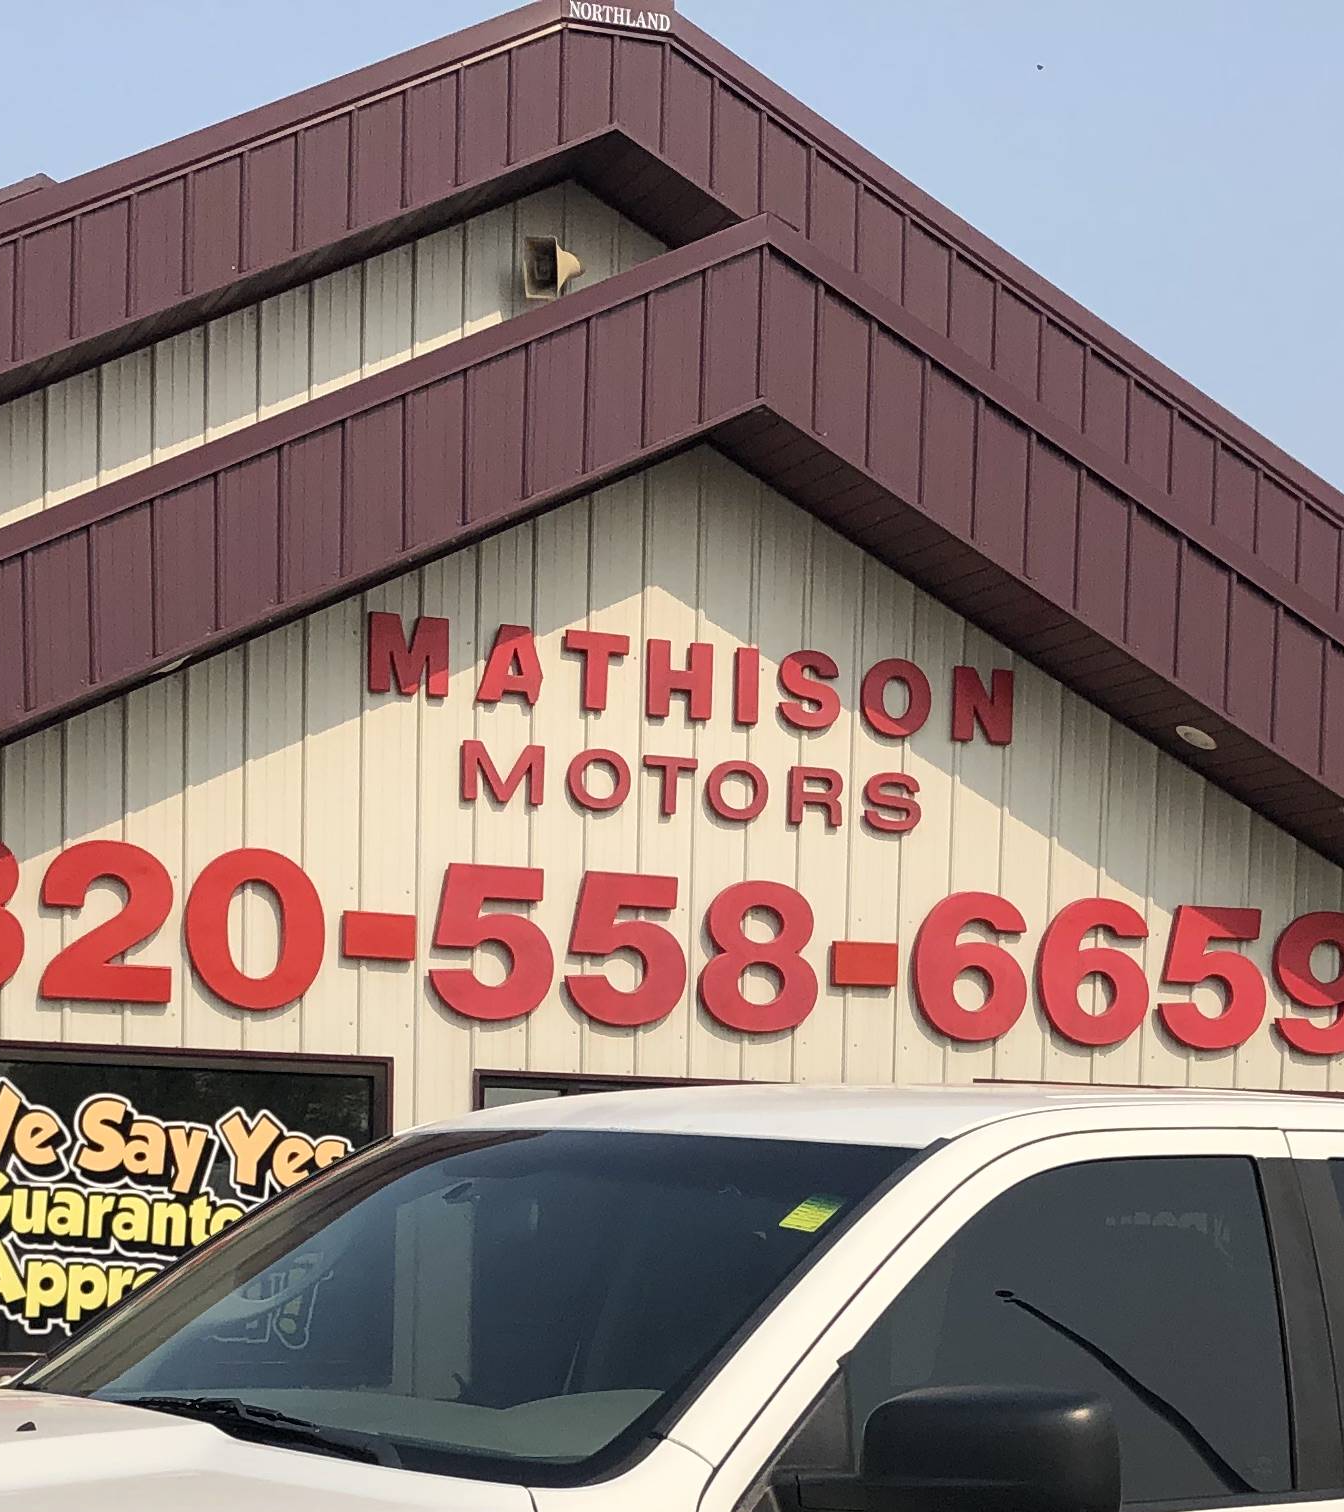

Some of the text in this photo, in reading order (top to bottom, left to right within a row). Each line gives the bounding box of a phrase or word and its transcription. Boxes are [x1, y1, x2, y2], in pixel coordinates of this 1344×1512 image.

[568, 0, 671, 32] NORTHLAND
[367, 610, 1014, 746] MATHISON
[459, 739, 923, 833] MOTORS
[75, 1096, 210, 1194] Say
